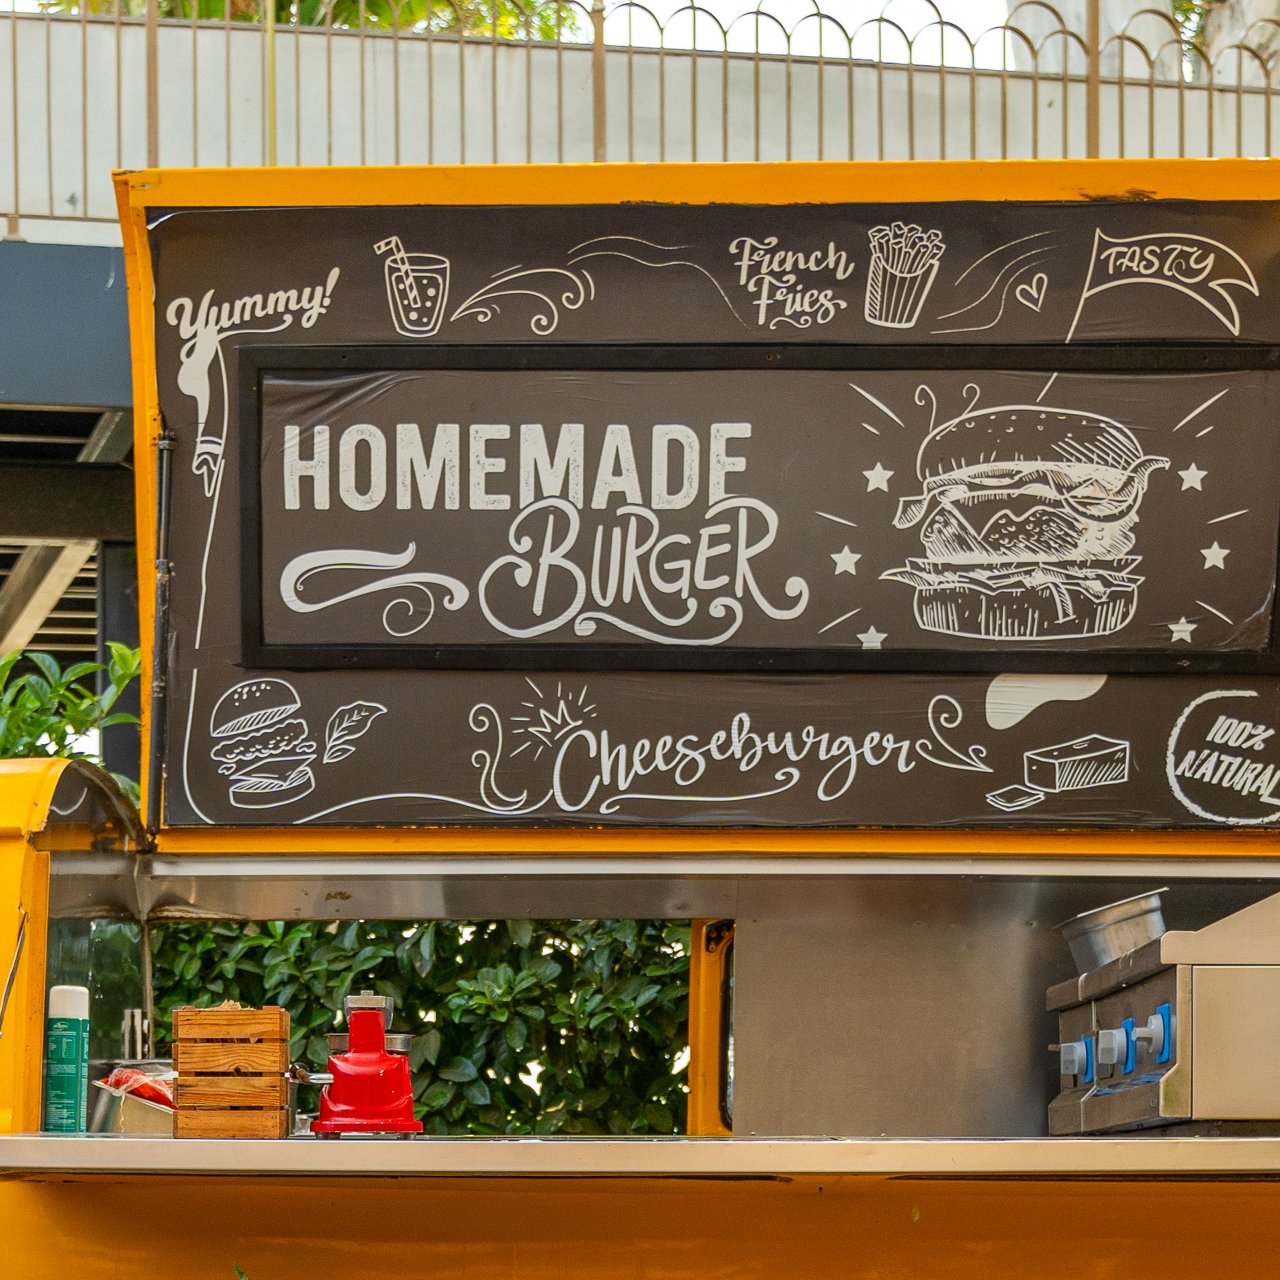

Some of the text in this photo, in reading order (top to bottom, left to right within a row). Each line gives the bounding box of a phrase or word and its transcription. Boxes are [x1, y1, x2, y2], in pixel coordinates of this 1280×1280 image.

[729, 236, 854, 285] French
[1100, 245, 1216, 284] TASTY
[166, 266, 341, 360] Yummy!
[748, 274, 848, 329] Fries
[283, 422, 752, 511] HOMEMADE
[478, 496, 810, 645] BURGER
[552, 713, 916, 813] Cheeseburger
[1206, 714, 1276, 750] 100%
